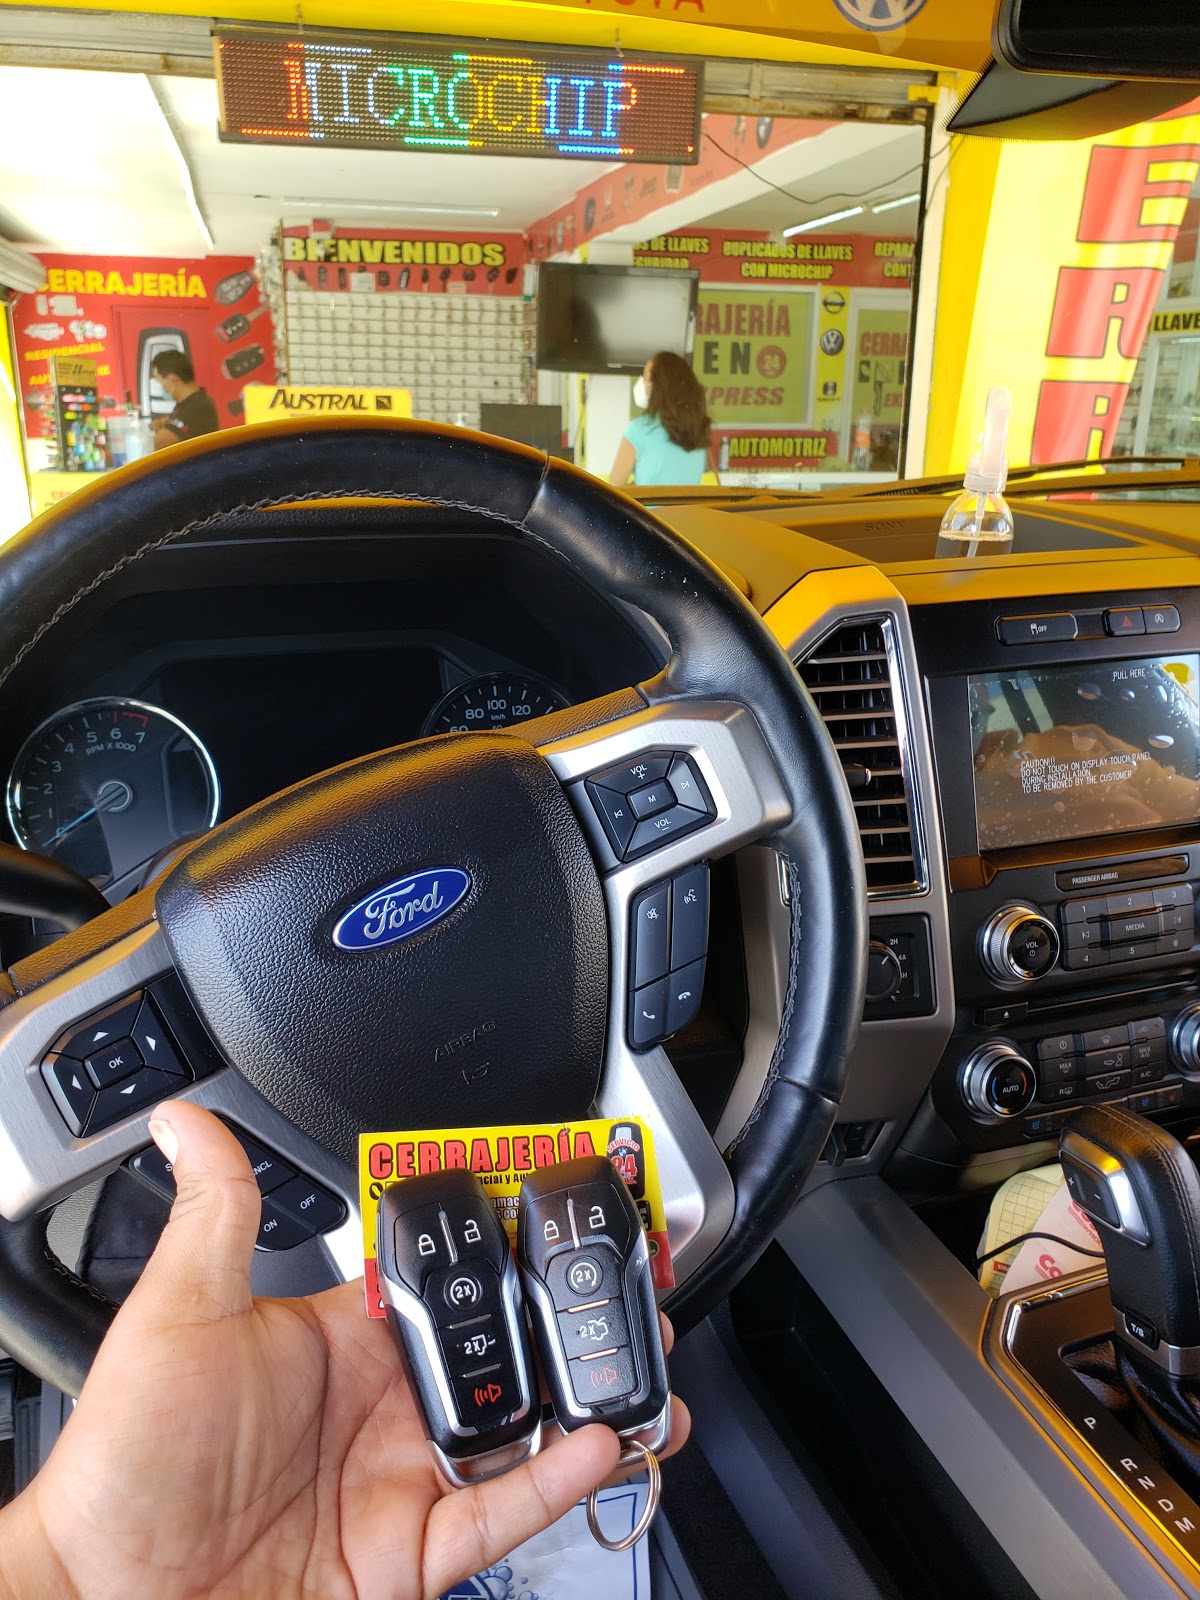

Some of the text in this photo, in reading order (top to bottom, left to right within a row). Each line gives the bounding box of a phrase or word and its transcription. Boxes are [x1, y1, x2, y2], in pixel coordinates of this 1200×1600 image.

[284, 237, 505, 266] BIENVENIDOS
[668, 237, 710, 253] LLAVES
[723, 240, 853, 261] DUPLICADOS DE LLAVES
[741, 261, 833, 280] CON MICROCHIP
[38, 267, 207, 299] ERRAJERÍA
[269, 389, 368, 411] AUSTRAL
[729, 437, 828, 457] AUTOMOTRIZ
[1038, 624, 1048, 633] OFF
[1112, 668, 1146, 682] PULL HERE
[487, 699, 507, 711] 100
[512, 704, 531, 716] 120
[465, 708, 485, 720] 80
[86, 731, 98, 743] 5
[110, 728, 122, 740] 6
[135, 731, 146, 744] 7
[64, 743, 75, 754] 4
[86, 743, 105, 756] RPM
[114, 742, 137, 752] 1000
[52, 761, 62, 773] 3
[630, 764, 648, 775] VOL
[1021, 751, 1152, 778] DO NOT TOUCH ON DISPLAY TOUCH PANEL
[1021, 769, 1091, 787] DURING INSTALLATION
[1023, 770, 1132, 794] TO BE REMOVED BY THE CUSTOMER
[43, 783, 53, 795] 2
[648, 794, 657, 804] M
[654, 817, 672, 829] VOL
[1072, 872, 1118, 885] PASSENGER AIRBAG
[1082, 891, 1177, 913] 1 2 3
[364, 880, 444, 940] Ford
[1125, 922, 1146, 932] MEDIA
[1025, 941, 1039, 949] VOL
[1083, 939, 1179, 963] 4 5 6
[434, 1021, 497, 1062] AIRBAG
[108, 1056, 124, 1069] OK
[1059, 1062, 1072, 1070] MAX
[1140, 1071, 1152, 1079] A/C
[1002, 1085, 1019, 1093] AUTO
[606, 1138, 641, 1153] SERVICIO
[369, 1128, 596, 1180] CERRAJERÍA
[253, 1160, 273, 1176] NCL
[610, 1153, 638, 1178] 24
[300, 1194, 317, 1210] OFF
[263, 1218, 278, 1233] ON
[575, 1270, 592, 1283] 2X
[455, 1285, 471, 1299] 2X
[579, 1324, 596, 1337] 2X
[1083, 1416, 1196, 1533] P R N D M
